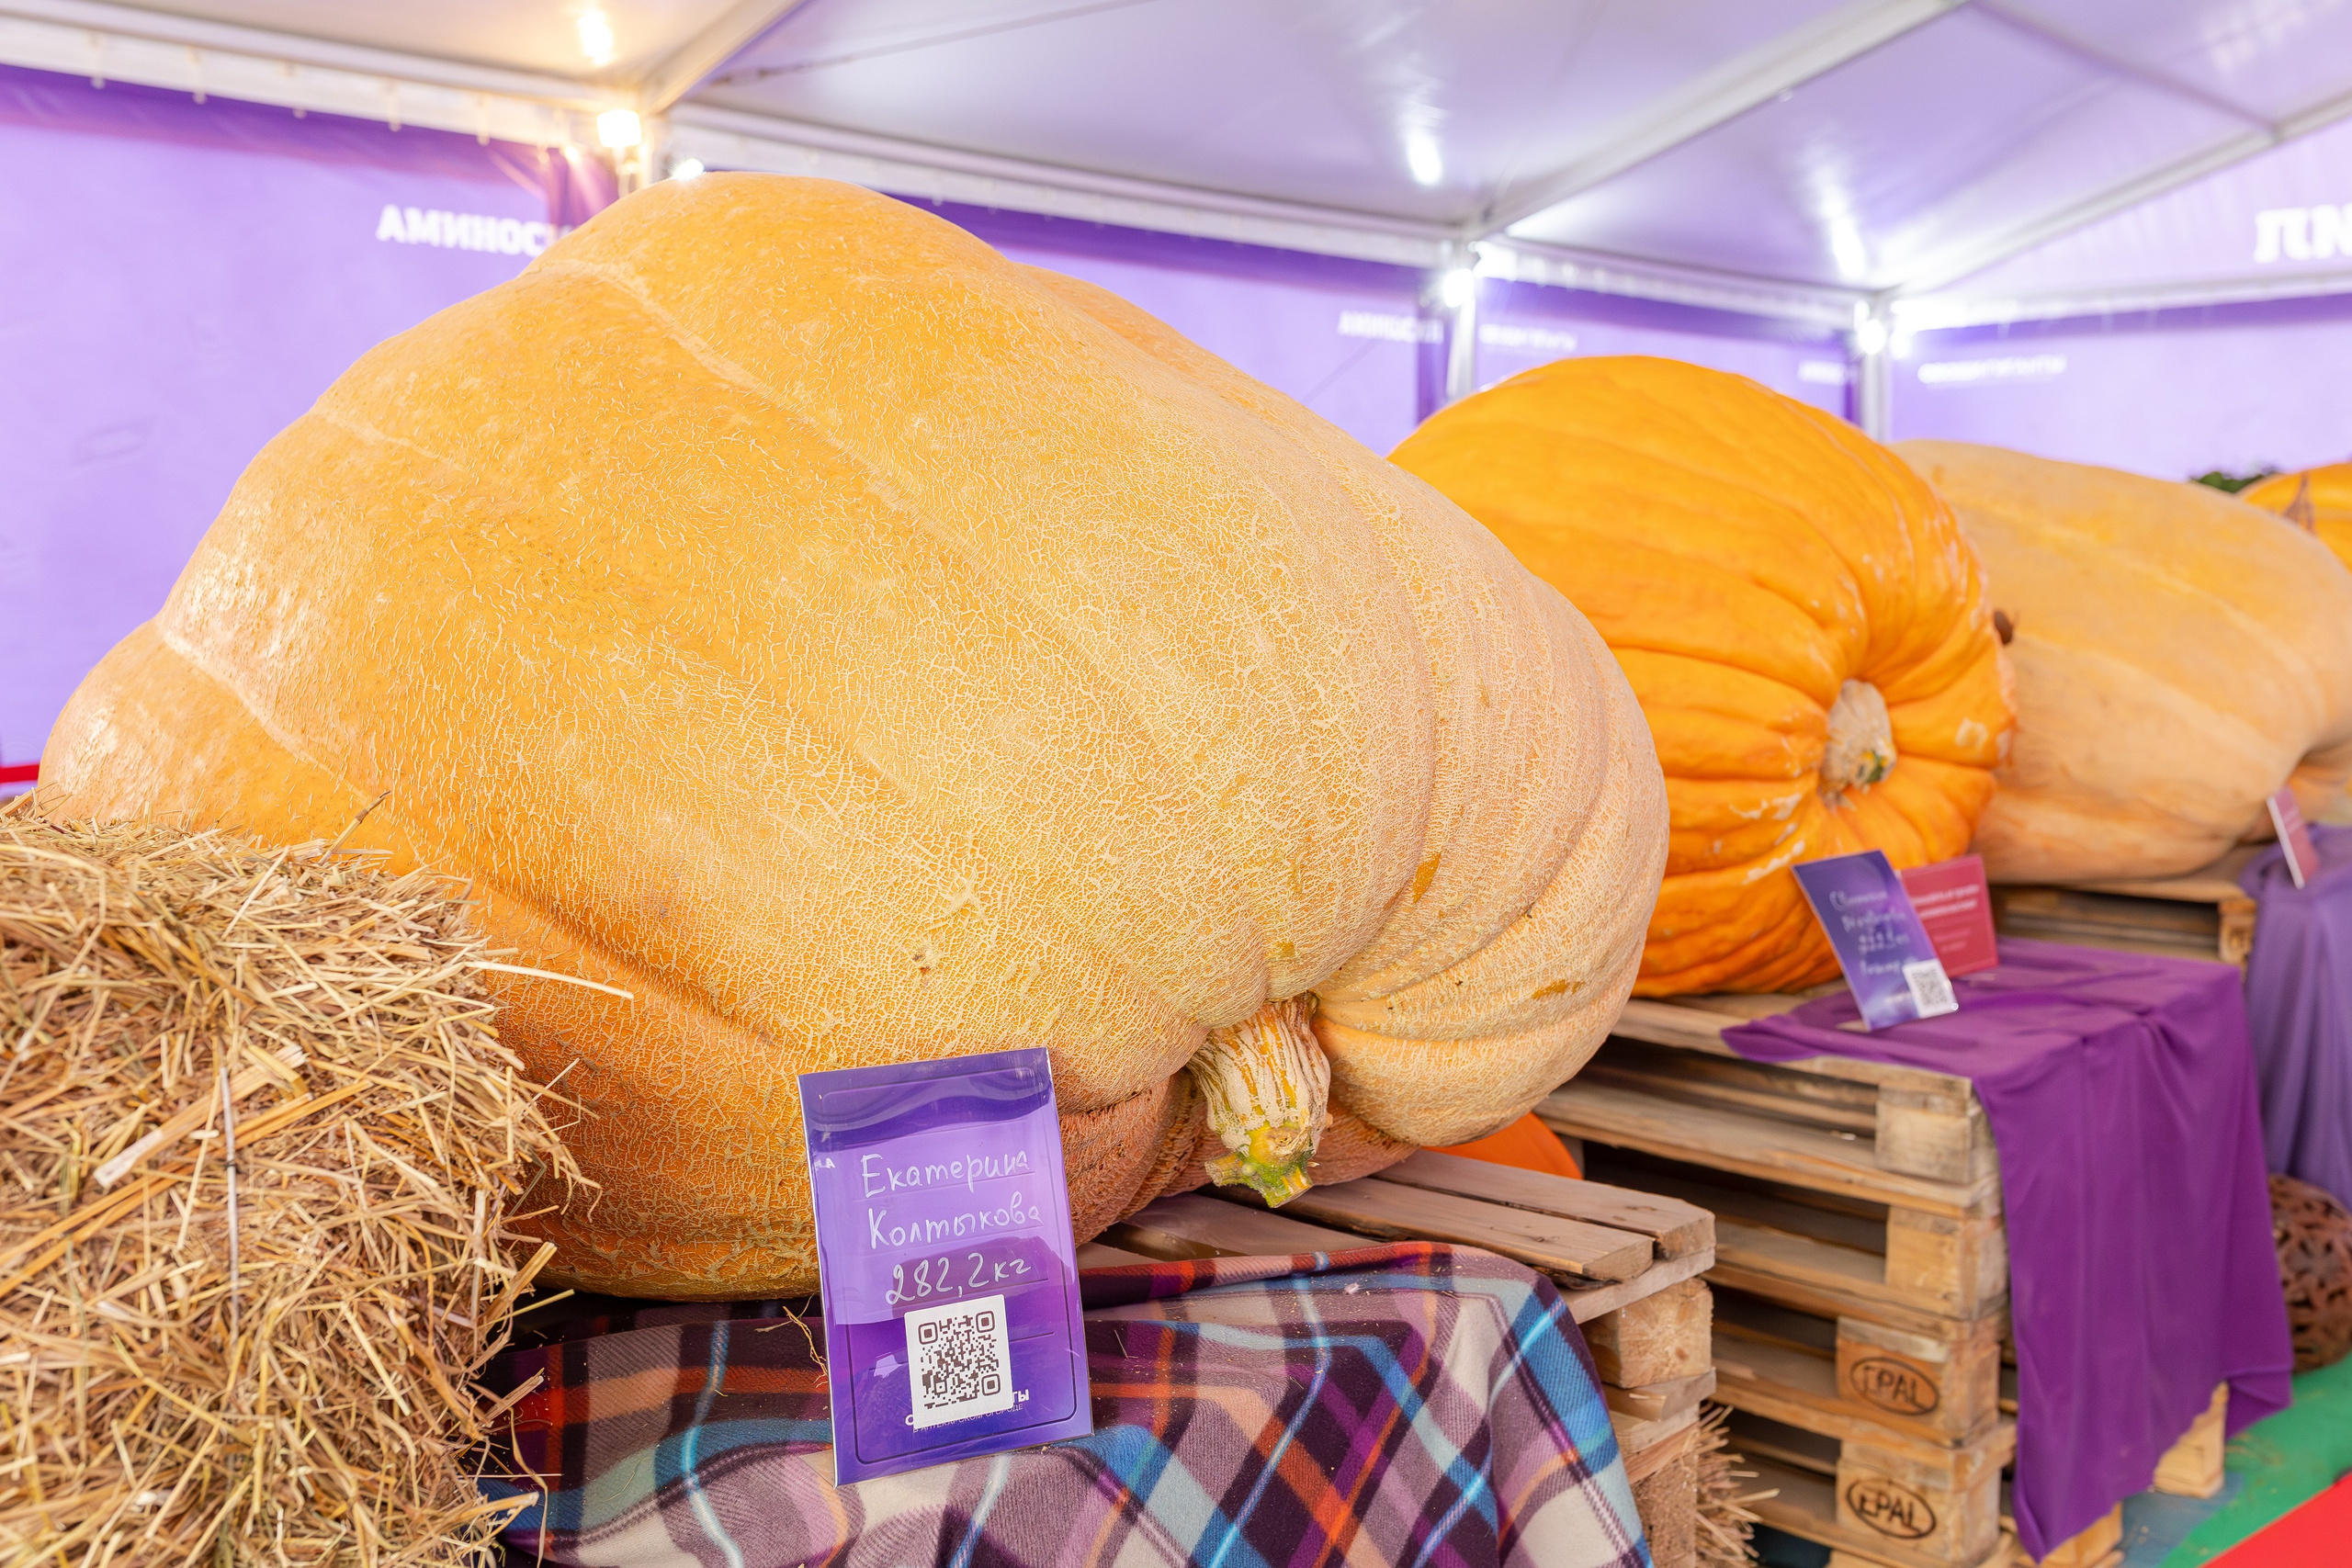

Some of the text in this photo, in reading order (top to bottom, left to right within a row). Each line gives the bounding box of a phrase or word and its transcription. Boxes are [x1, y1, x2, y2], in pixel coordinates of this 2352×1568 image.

[375, 204, 575, 258] АМИНОС
[861, 1151, 1031, 1198] Екатерина
[1859, 1484, 1921, 1533] EPAL
